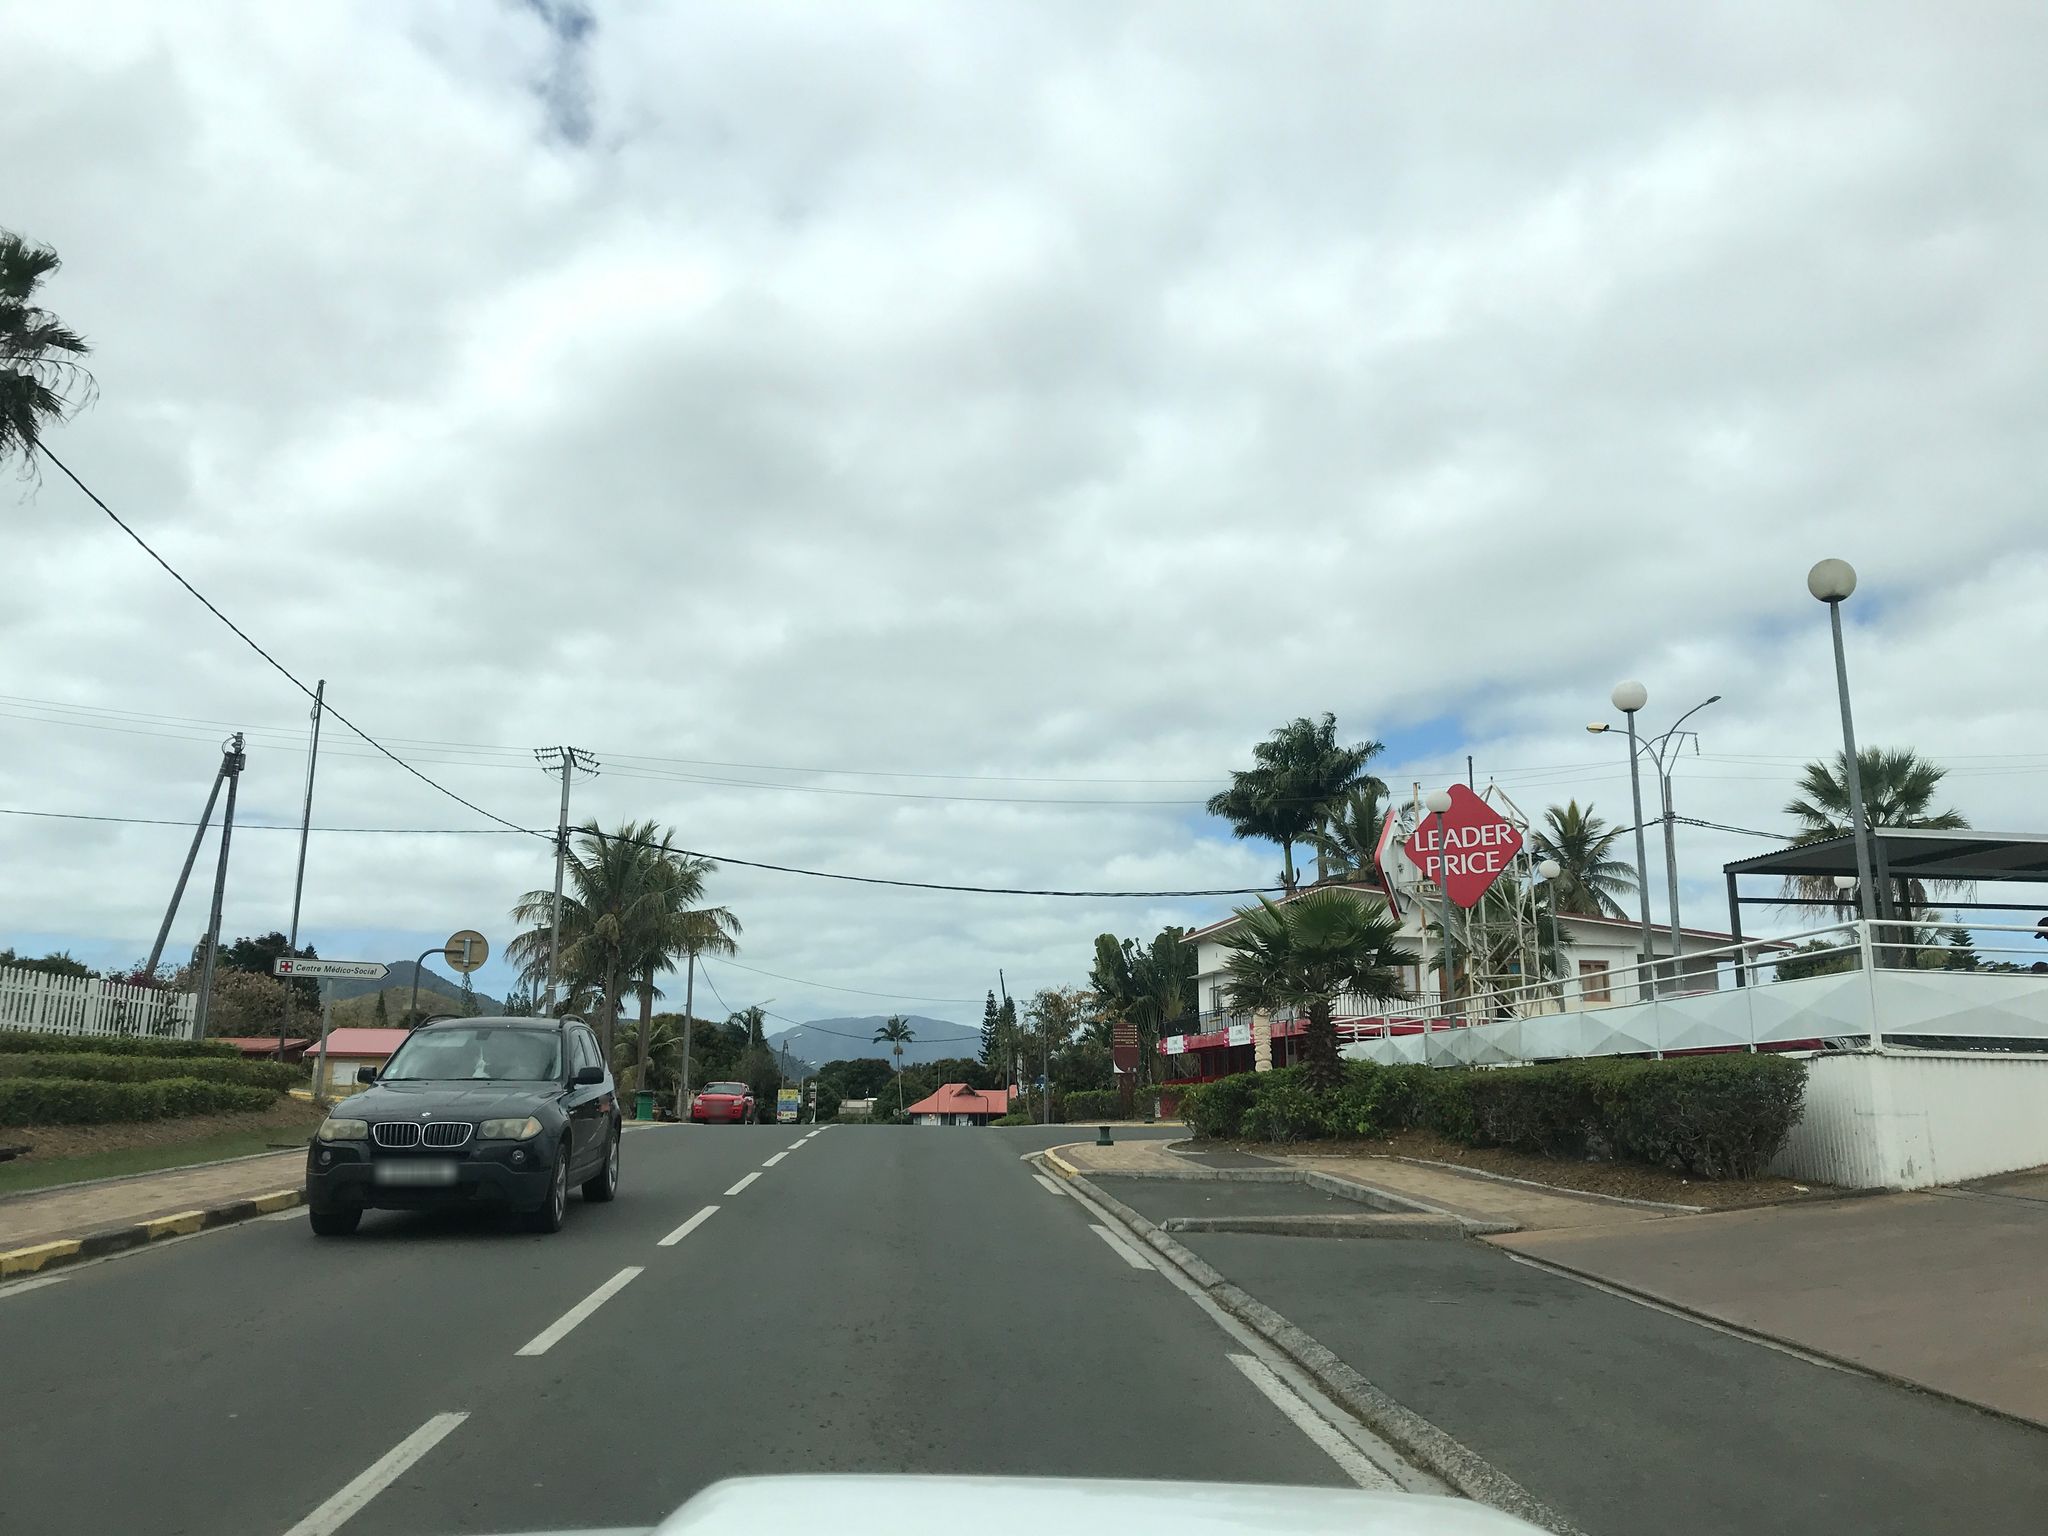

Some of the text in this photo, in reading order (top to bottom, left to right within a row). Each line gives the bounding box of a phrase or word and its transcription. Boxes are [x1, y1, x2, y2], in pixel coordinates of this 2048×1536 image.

[1414, 823, 1513, 852] LEADER
[1426, 851, 1501, 877] PRICE
[296, 964, 378, 975] Centre Médico-Social
